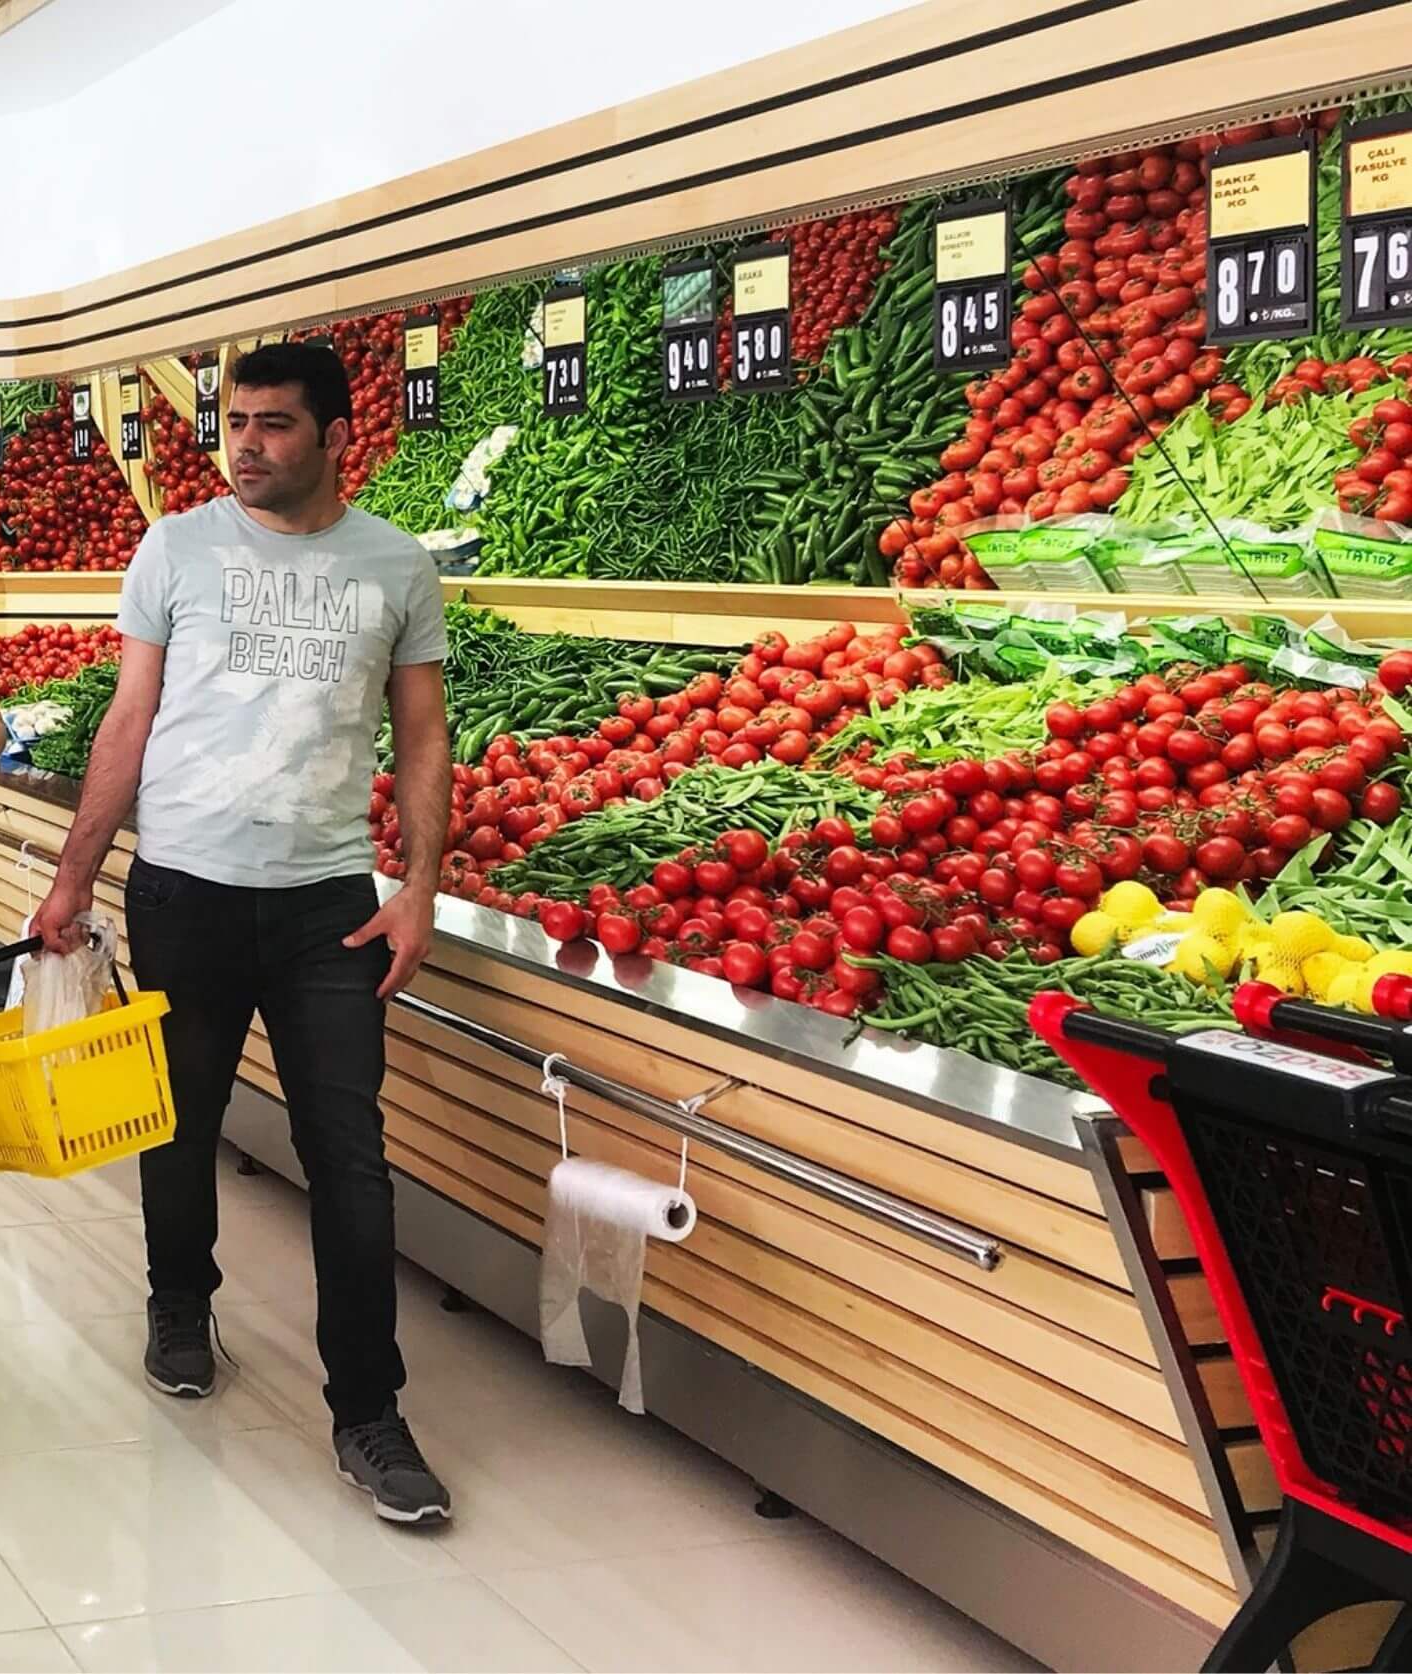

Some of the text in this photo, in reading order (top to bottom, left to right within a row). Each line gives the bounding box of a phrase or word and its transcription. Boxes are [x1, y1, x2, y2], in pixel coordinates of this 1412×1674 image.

[1367, 147, 1396, 160] ÇALI
[1355, 157, 1407, 174] FASULYE
[1215, 173, 1257, 188] SAKIZ
[1372, 173, 1389, 184] KG
[1214, 183, 1261, 200] BAKLA
[1227, 198, 1248, 209] KG
[220, 567, 360, 635] PALM
[228, 631, 347, 683] BEACH
